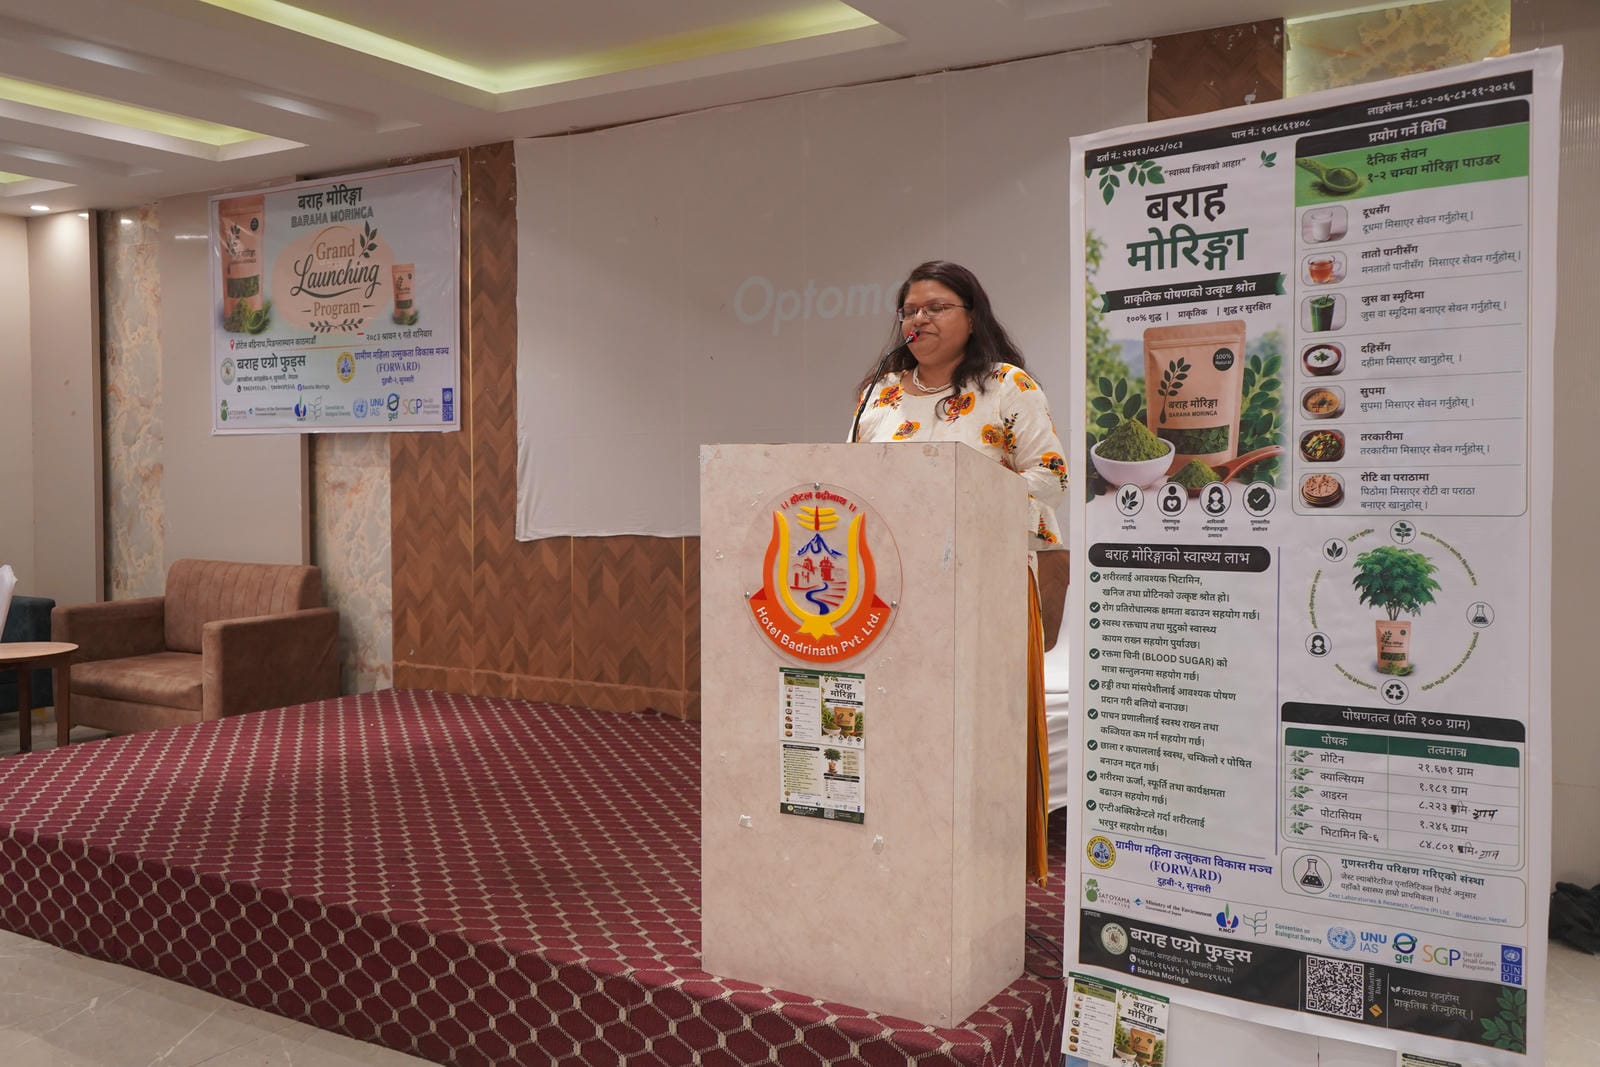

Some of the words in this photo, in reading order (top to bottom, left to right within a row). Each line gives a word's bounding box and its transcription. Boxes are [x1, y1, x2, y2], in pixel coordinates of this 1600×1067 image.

[1368, 127, 1398, 143] प्रयोग
[1400, 122, 1418, 137] गर्ने
[1420, 119, 1447, 133] विधि
[1367, 152, 1397, 166] दैनिक
[1400, 147, 1427, 159] सेवन
[1367, 171, 1386, 183] १-२
[1389, 165, 1417, 179] चम्चा
[1421, 160, 1459, 175] मोरिङ्गा
[1462, 154, 1500, 168] पाउडर
[1145, 184, 1227, 222] बराह
[291, 212, 328, 228] BARAHA
[331, 206, 374, 222] MORINGA
[1385, 217, 1414, 229] मिसाएर
[1416, 214, 1436, 225] सेवन
[316, 239, 355, 260] Grand
[1126, 224, 1248, 271] मोरिङ्गा
[1361, 247, 1381, 259] तातो
[290, 254, 381, 299] Launching
[1123, 289, 1161, 306] प्राकृतिक
[1164, 285, 1202, 301] पोषणको
[1236, 280, 1256, 293] श्रोत
[1361, 295, 1378, 306] जुस
[1380, 294, 1390, 302] वा
[314, 302, 360, 319] Program
[261, 353, 278, 368] एग्रो
[377, 362, 420, 373] (FORWARD)
[1360, 387, 1385, 398] सुपमा
[403, 399, 422, 415] SGP
[1385, 398, 1414, 409] मिसाएर
[1417, 397, 1436, 408] सेवन
[1360, 431, 1403, 442] तरकारीमा
[1360, 445, 1398, 456] तरकारीमा
[1400, 444, 1430, 455] मिसाएर
[1433, 444, 1452, 454] सेवन
[1360, 471, 1378, 482] रोटि
[1381, 473, 1391, 482] वा
[1392, 473, 1429, 482] पराठामा
[1441, 486, 1450, 496] वा
[1452, 486, 1475, 496] पराठा
[1105, 549, 1128, 563] बराह
[1132, 547, 1180, 564] मोरिङ्गाको
[1183, 551, 1221, 564] स्वास्थ्य
[1224, 552, 1251, 564] लाभ
[1103, 571, 1132, 582] शरीरलाई
[1134, 574, 1167, 583] आवश्यक
[1102, 588, 1124, 597] खनिज
[1126, 590, 1140, 598] तथा
[1143, 588, 1174, 600] प्रोटिनको
[1102, 602, 1114, 612] रोग
[1161, 608, 1182, 616] क्षमता
[1212, 609, 1240, 619] सहयोग
[757, 606, 782, 639] Hotel
[781, 635, 839, 656] Badrinath
[841, 637, 864, 652] Pvt.
[862, 611, 881, 636] Ltd.
[1102, 619, 1120, 628] स्वस्थ
[1150, 622, 1164, 630] तथा
[1102, 635, 1122, 643] कायम
[1143, 636, 1168, 647] सहयोग
[1123, 650, 1140, 660] चिनी
[1142, 653, 1176, 663] (BLOOD
[1179, 655, 1214, 667] SUGAR)
[1216, 656, 1228, 667] को
[1102, 665, 1116, 673] मात्रा
[1156, 669, 1181, 679] सहयोग
[1115, 682, 1130, 690] तथा
[1178, 688, 1210, 698] आवश्यक
[1213, 689, 1236, 700] पोषण
[1101, 694, 1118, 705] प्रदान
[1120, 696, 1132, 706] गरी
[1101, 710, 1119, 720] पाचन
[1121, 712, 1158, 726] प्रणालीलाई
[1161, 718, 1180, 727] स्वस्थ
[1182, 720, 1201, 730] राख्न
[1203, 722, 1219, 731] तथा
[1342, 709, 1390, 723] पोषणतत्व
[1393, 711, 1416, 726] (प्रति
[1421, 716, 1442, 727] १००
[1446, 717, 1470, 731] ग्राम)
[1133, 730, 1145, 739] कम
[1148, 730, 1158, 740] गर्न
[1161, 733, 1186, 744] सहयोग
[1322, 735, 1348, 746] पोषक
[1100, 742, 1117, 750] छाला
[1220, 757, 1224, 765] र
[1227, 755, 1252, 768] पोषित
[1320, 752, 1344, 764] प्रोटिन
[1456, 766, 1474, 777] ग्राम
[1169, 782, 1184, 792] तथा
[1451, 786, 1468, 796] ग्राम
[1124, 790, 1149, 803] सहयोग
[1320, 789, 1347, 801] आइरन
[1120, 822, 1144, 833] सहयोग
[1172, 813, 1205, 828] शरीरलाई
[1321, 807, 1362, 822] पोटासियम
[1451, 824, 1468, 835] ग्राम
[1321, 826, 1356, 840] भिटामिन
[1115, 838, 1142, 853] ग्रामीण
[1144, 844, 1172, 859] महिला
[1174, 850, 1211, 866] उत्सुकता
[1214, 855, 1245, 871] विकास
[1249, 862, 1273, 875] मञ्च
[1150, 860, 1222, 884] (FORWARD)
[1341, 858, 1383, 871] गुणस्तरीय
[1422, 869, 1457, 882] गरिएको
[1460, 875, 1485, 886] संस्था
[1186, 880, 1211, 894] सुनसरी
[1360, 931, 1387, 944] UNU
[1130, 928, 1168, 948] बराह
[1171, 936, 1200, 953] एग्रो
[1204, 943, 1252, 966] फुड्स
[1360, 943, 1379, 953] IAS
[1395, 953, 1414, 963] gef
[1423, 945, 1461, 966] SGP
[1137, 967, 1160, 978] Baraha
[1162, 972, 1189, 984] Moringa
[1393, 998, 1428, 1011] प्राकृतिक
